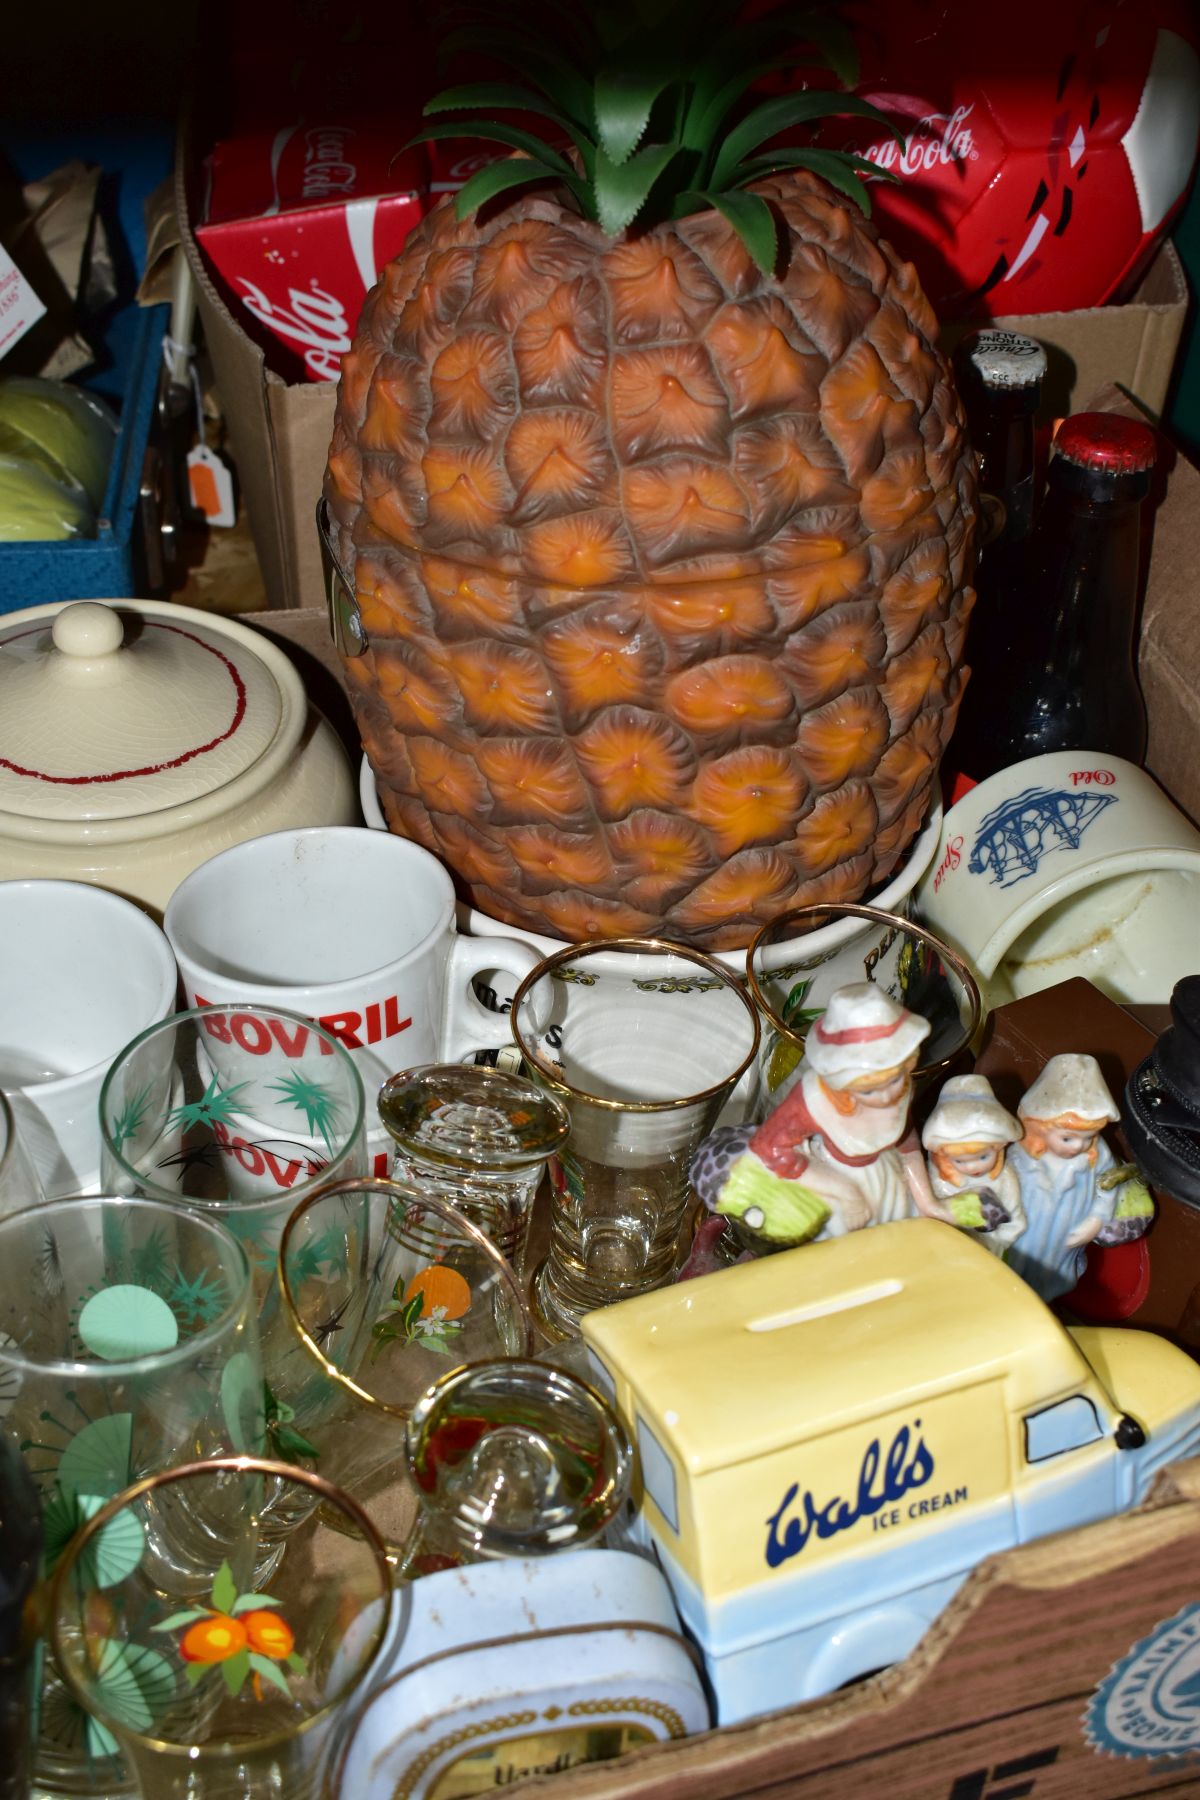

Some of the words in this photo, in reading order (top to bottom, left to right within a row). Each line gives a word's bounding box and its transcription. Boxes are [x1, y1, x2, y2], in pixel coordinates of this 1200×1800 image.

[1069, 769, 1116, 786] Old
[933, 836, 964, 894] Spice
[195, 995, 413, 1058] BOVRIL
[765, 1418, 934, 1568] Wall's
[872, 1509, 900, 1532] ICE
[908, 1485, 968, 1519] CREAM
